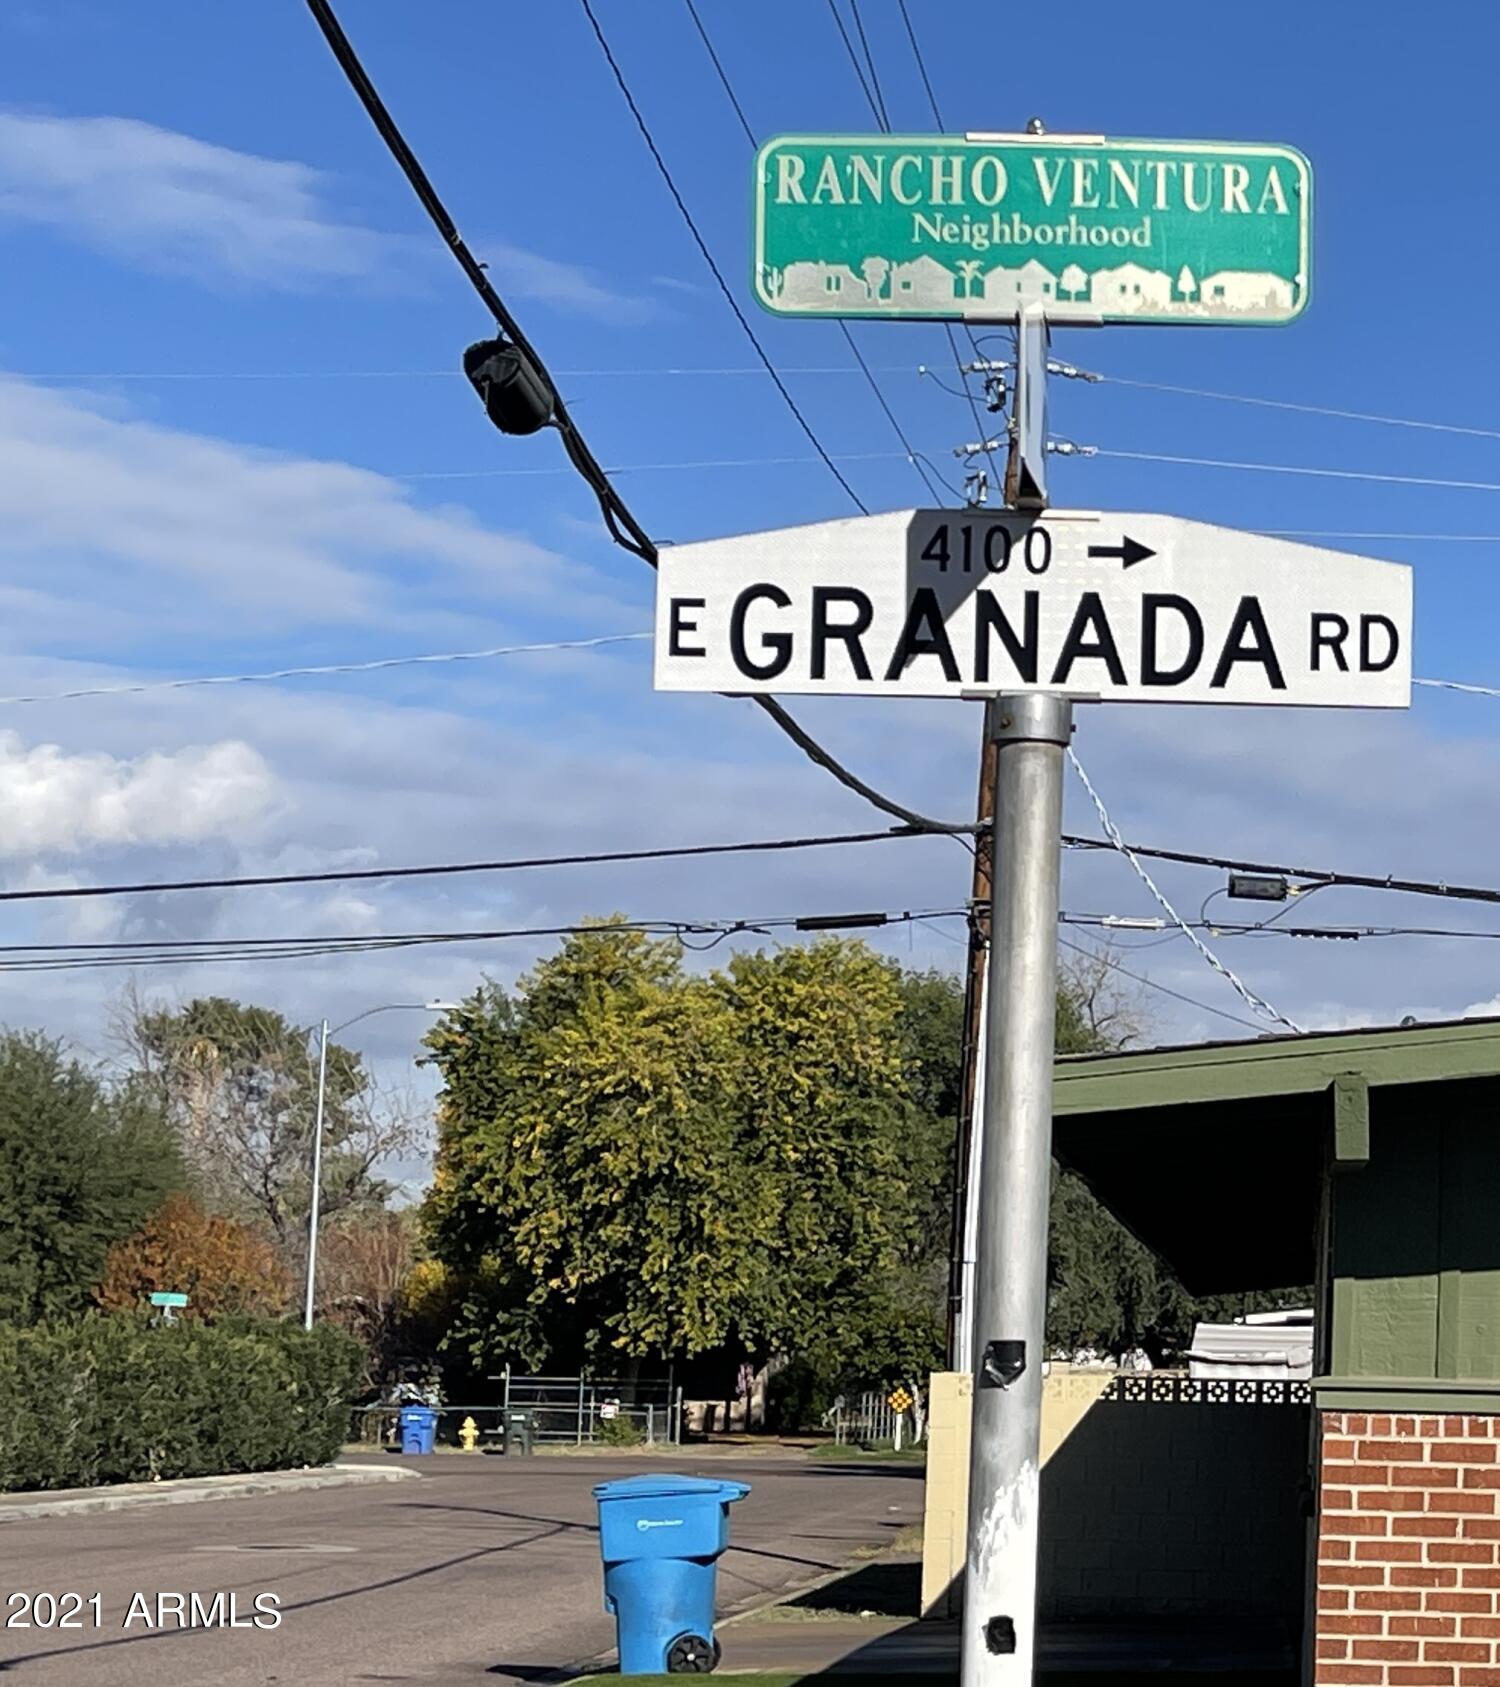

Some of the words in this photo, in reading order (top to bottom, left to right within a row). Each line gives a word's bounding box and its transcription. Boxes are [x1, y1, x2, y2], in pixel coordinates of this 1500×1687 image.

[775, 153, 1008, 207] RANCHO
[1033, 157, 1291, 215] VENTURA
[911, 213, 1151, 248] Neighborhood
[921, 525, 1052, 574] 4100
[669, 597, 706, 657] E
[729, 583, 1287, 690] GRANADA
[1310, 613, 1399, 673] RD
